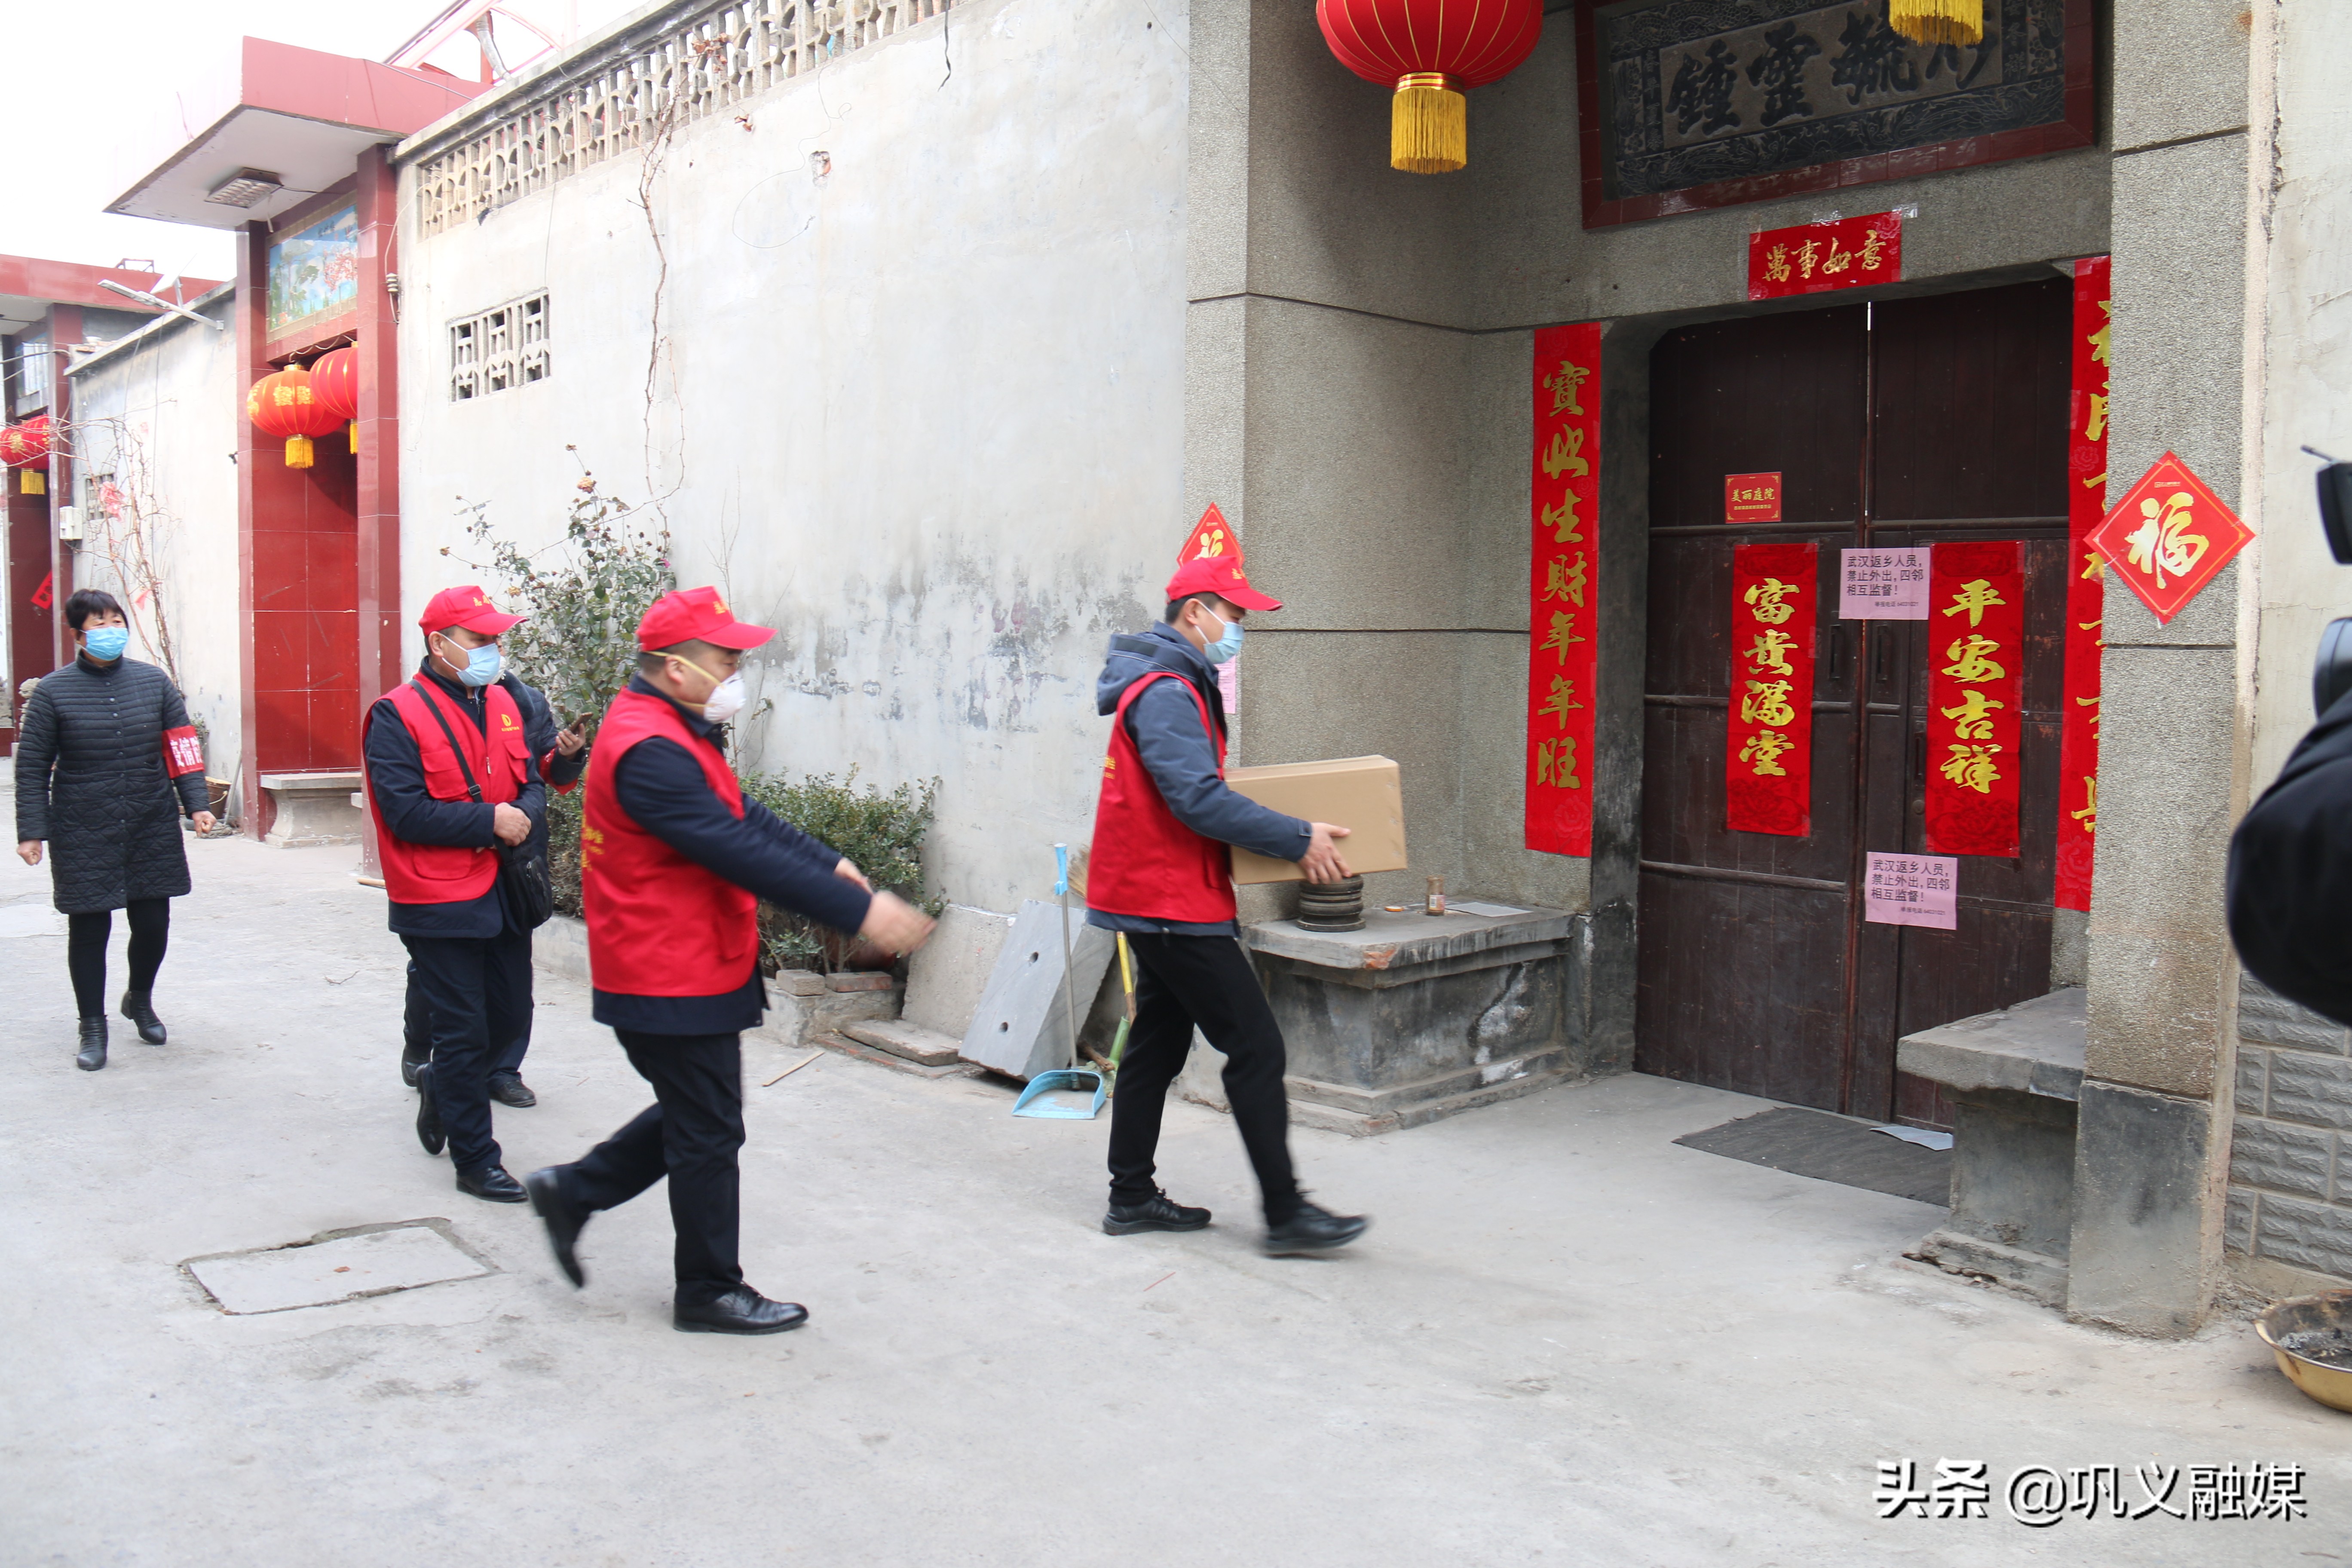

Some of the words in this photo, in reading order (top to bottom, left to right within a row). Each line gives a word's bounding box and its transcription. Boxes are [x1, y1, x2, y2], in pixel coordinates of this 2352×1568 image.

[1762, 229, 1886, 282] 萬事如意
[1731, 488, 1775, 502] 美丽庭院
[2124, 492, 2210, 589] 福
[1940, 579, 2006, 794] 平安吉祥
